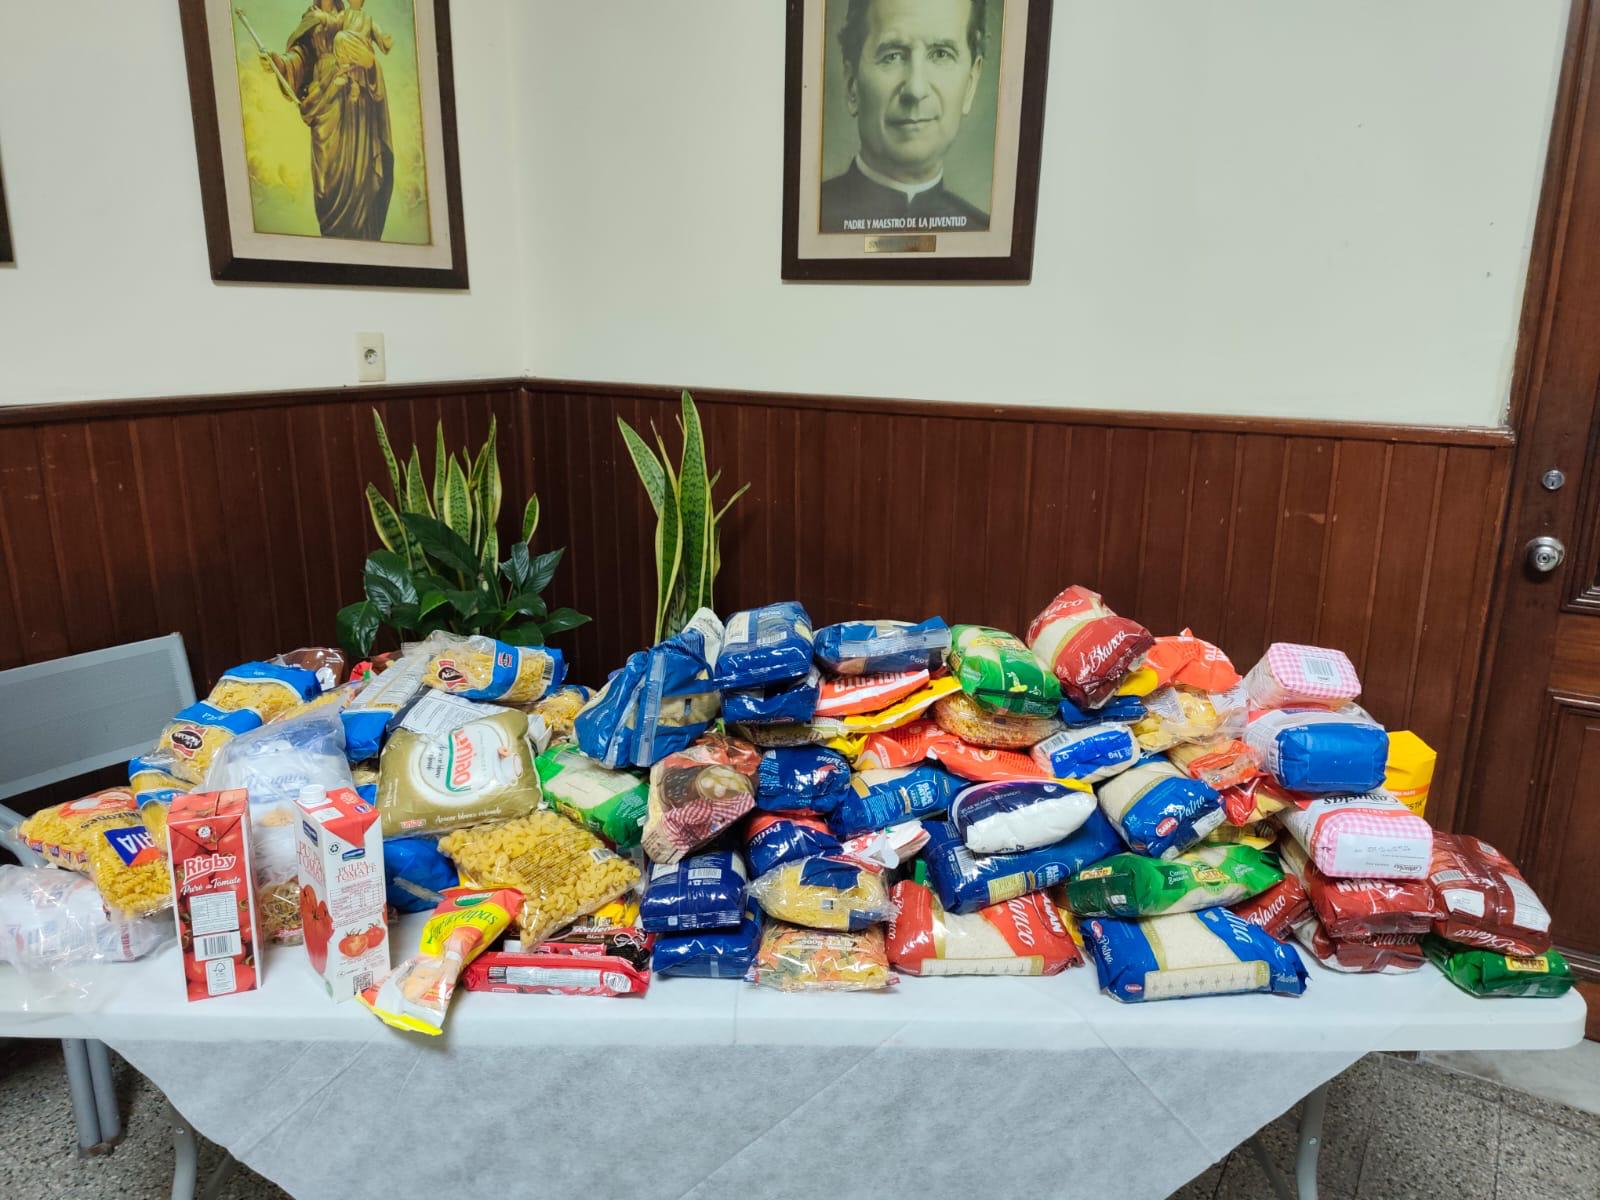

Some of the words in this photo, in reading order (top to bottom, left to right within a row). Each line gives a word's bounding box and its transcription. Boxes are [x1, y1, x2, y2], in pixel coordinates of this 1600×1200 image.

[843, 217, 866, 231] PADRE
[866, 218, 872, 229] Y
[872, 217, 906, 229] MAESTRO
[906, 216, 916, 228] DE
[918, 216, 928, 228] LA
[929, 215, 967, 230] JUVENTUD
[116, 831, 155, 854] RIA
[184, 853, 237, 880] Rigby
[210, 876, 242, 890] Tomate
[1248, 894, 1287, 926] Blanco
[1007, 896, 1036, 948] lanco
[1456, 928, 1517, 950] Blanco
